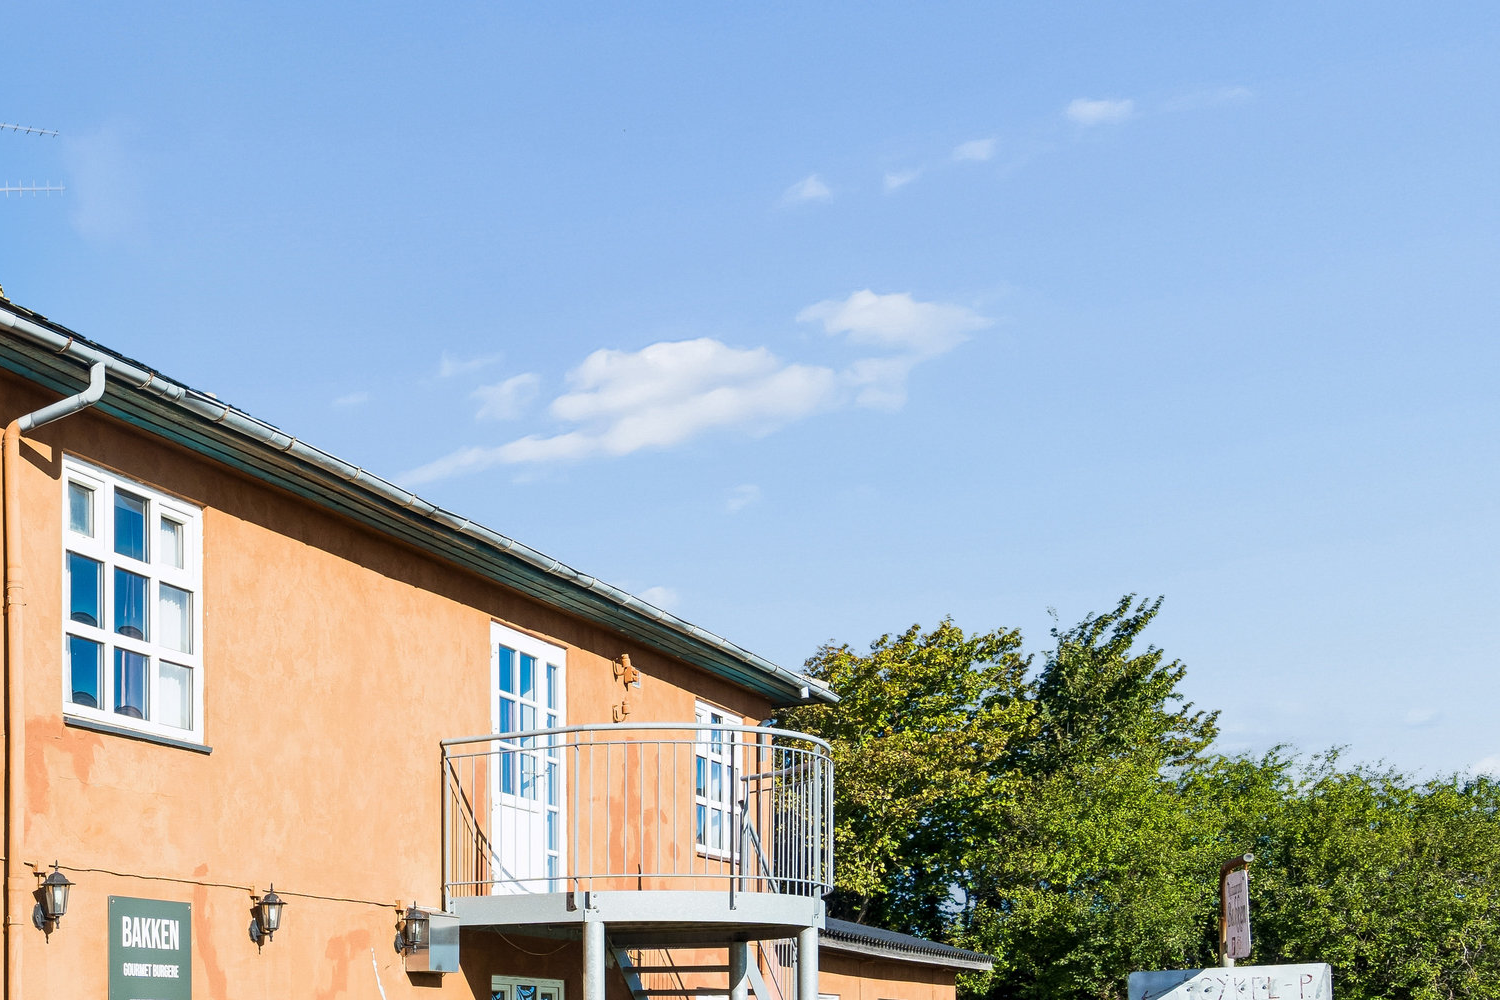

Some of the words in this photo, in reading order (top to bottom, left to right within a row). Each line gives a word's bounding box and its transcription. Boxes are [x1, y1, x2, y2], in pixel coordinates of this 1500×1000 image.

[122, 915, 180, 951] BAKKEN
[123, 962, 152, 977] GOURMET
[152, 964, 180, 979] BURGERE
